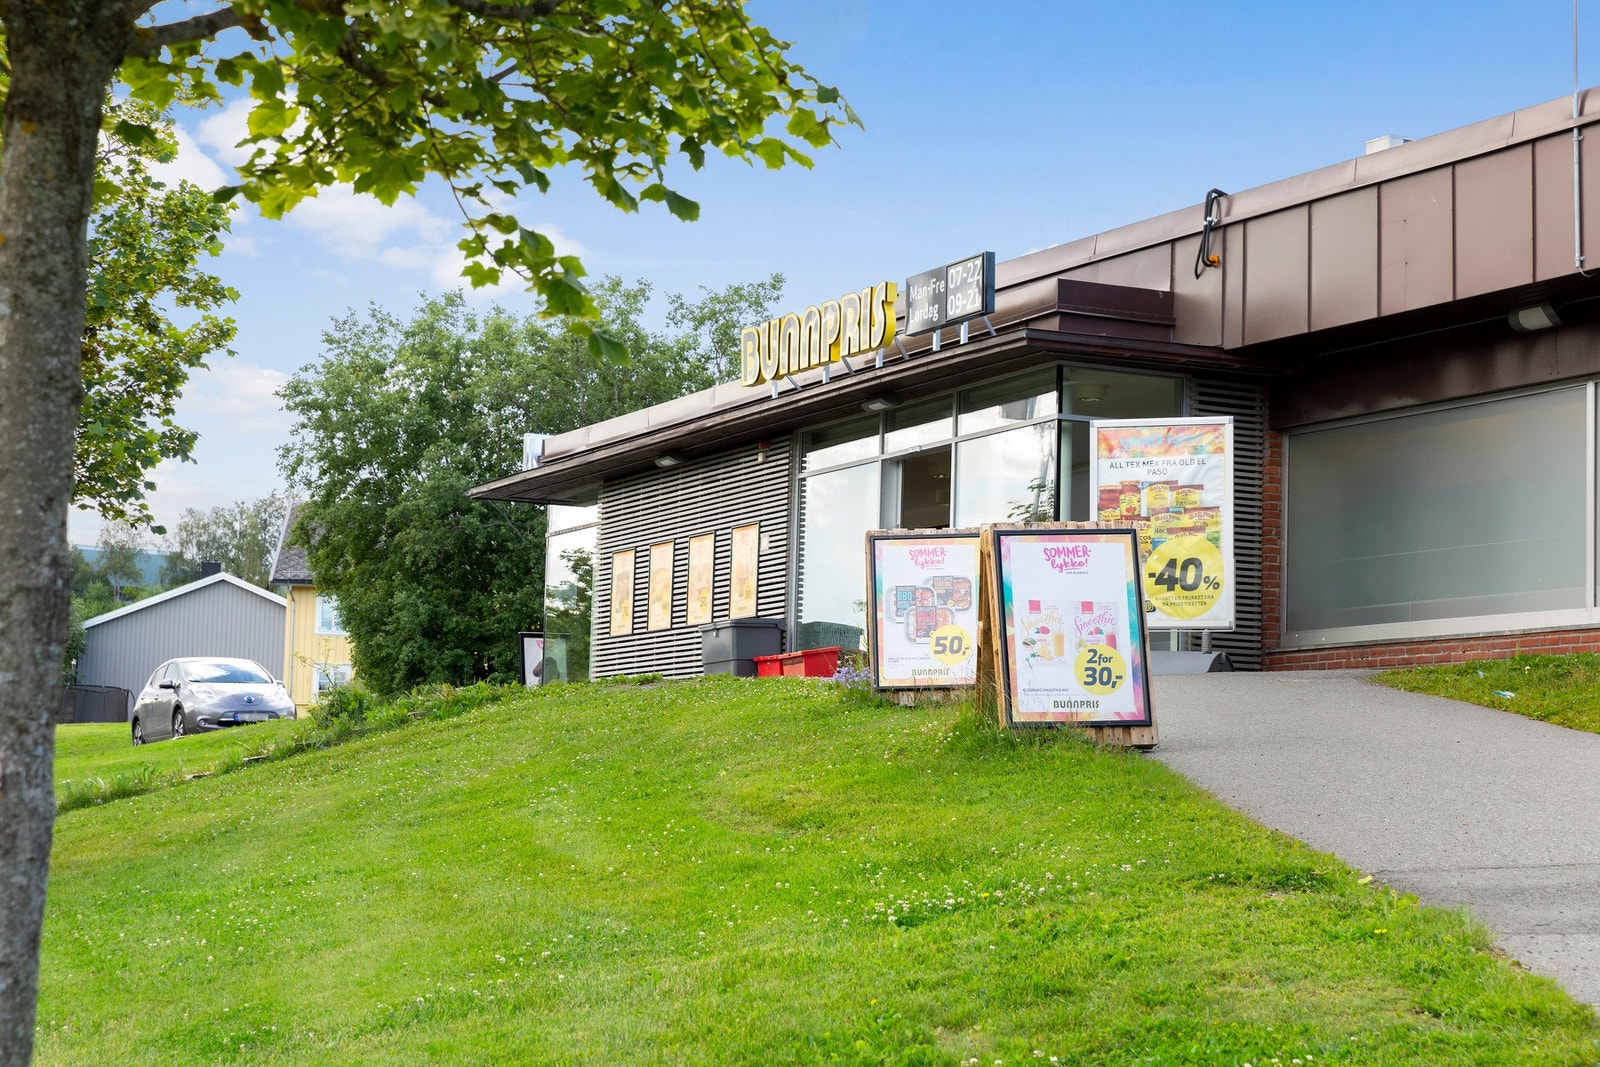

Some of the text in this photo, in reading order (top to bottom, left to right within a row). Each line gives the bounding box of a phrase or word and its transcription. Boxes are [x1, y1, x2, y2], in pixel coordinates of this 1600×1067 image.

[909, 260, 981, 302] Man-Fre 07-22
[909, 288, 980, 324] Lørdag 09-21
[741, 281, 893, 388] BUNNPRIS
[1109, 457, 1207, 470] ALL TEX MEX FRA OLD EL
[1146, 467, 1168, 476] PASO
[897, 591, 912, 601] BBQ
[911, 668, 950, 676] BUNNPRIS
[1083, 666, 1123, 688] 30,-
[1053, 700, 1099, 709] BUNNPRIS
